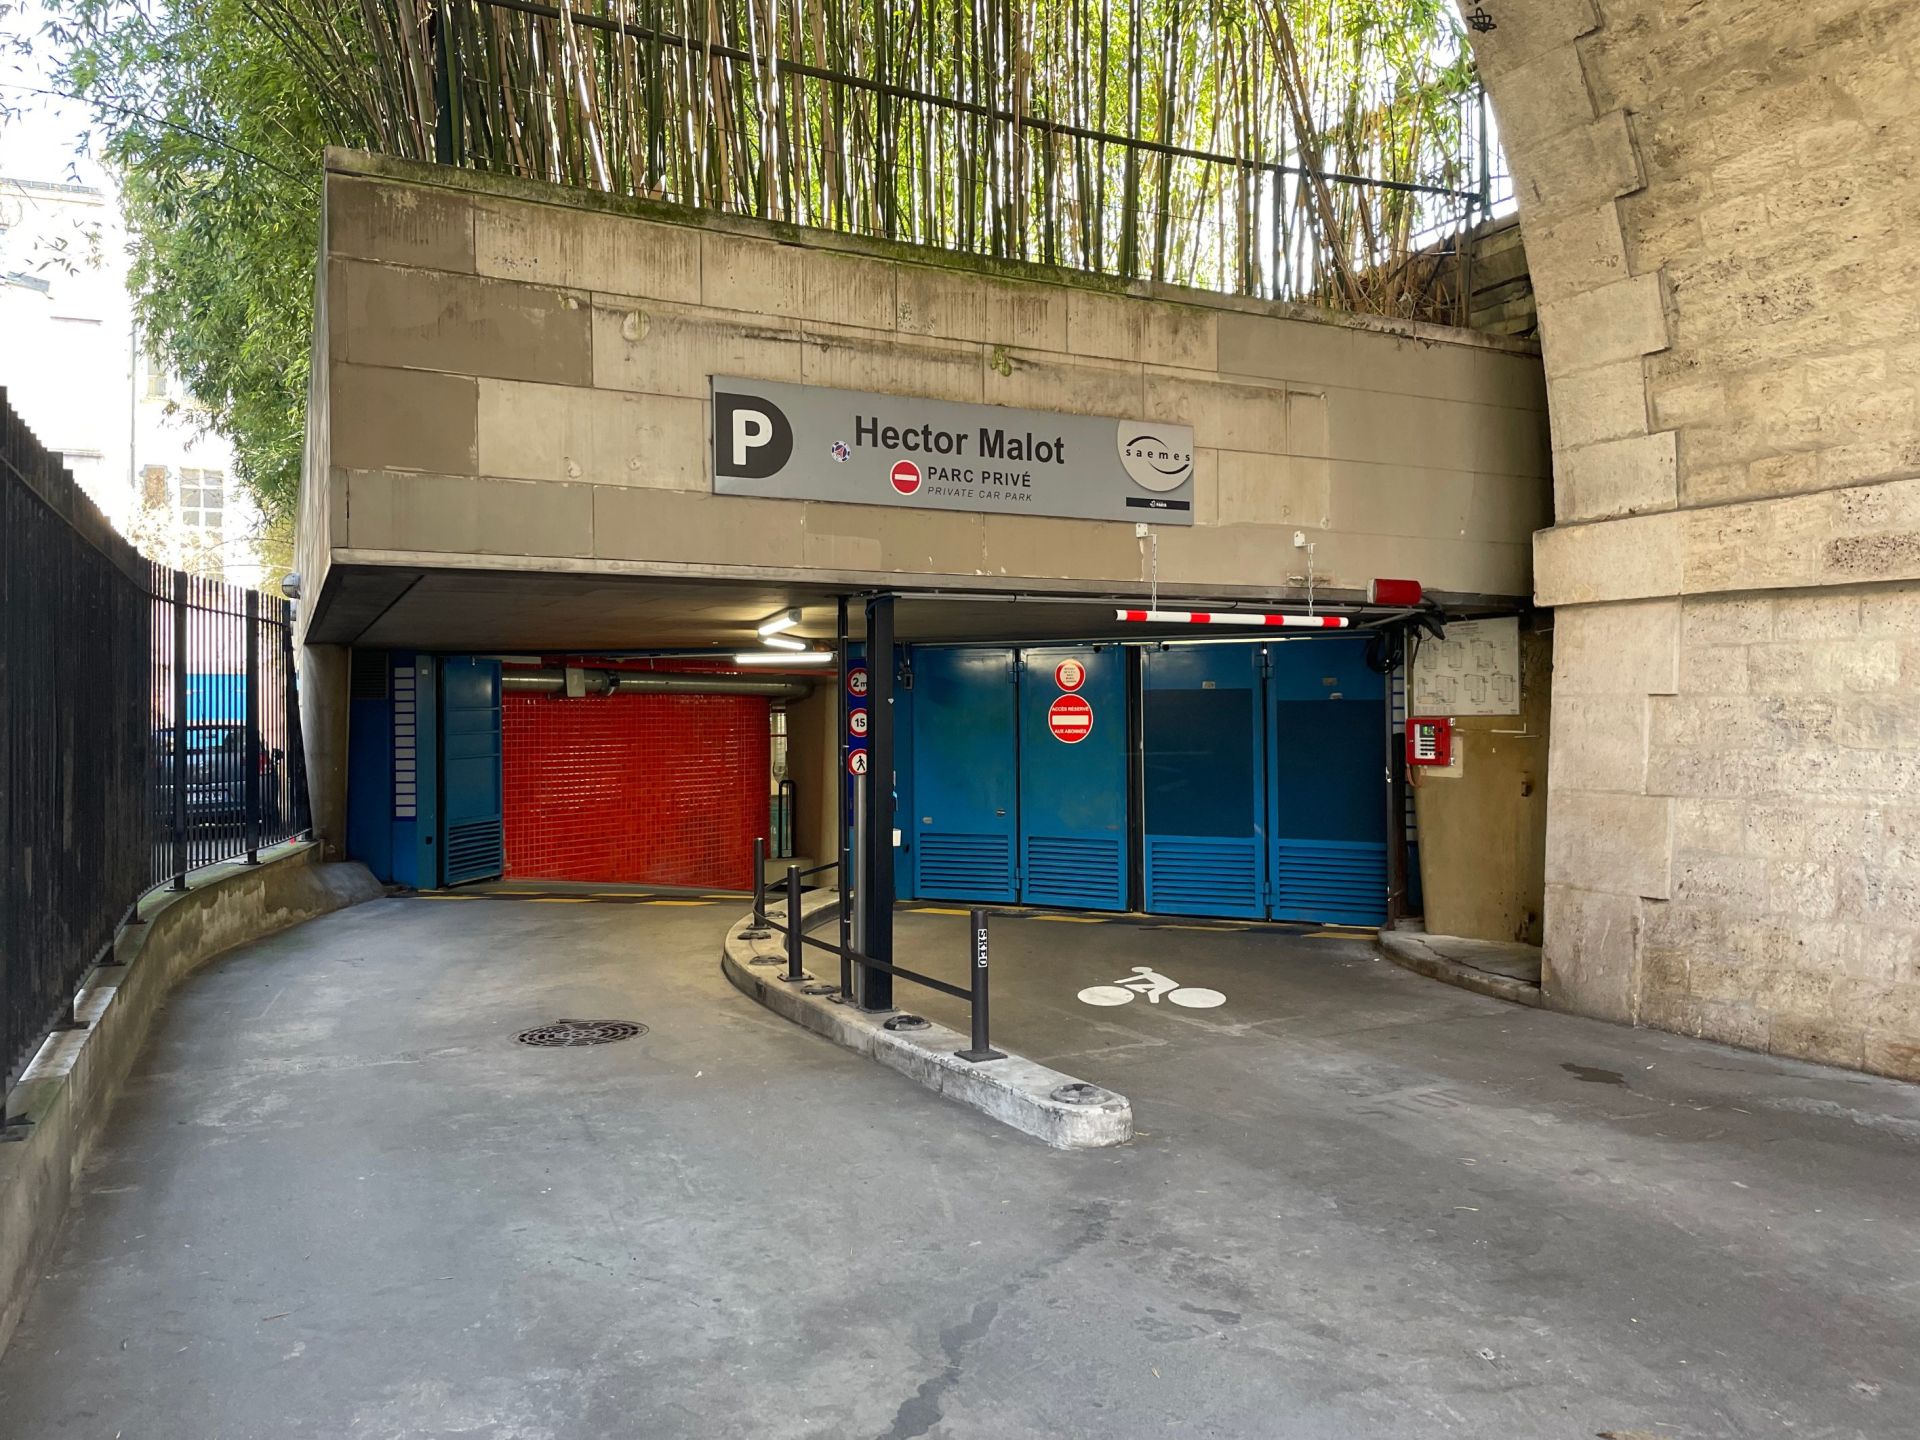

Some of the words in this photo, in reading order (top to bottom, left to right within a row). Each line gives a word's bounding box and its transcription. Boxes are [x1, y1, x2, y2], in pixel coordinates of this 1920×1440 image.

[733, 409, 773, 466] P
[855, 415, 969, 455] Hector
[979, 427, 1065, 464] Malot
[1126, 449, 1190, 461] saemes
[928, 466, 974, 483] PARC
[981, 471, 1031, 488] PRIVÉ
[927, 486, 974, 498] PRIVATE
[978, 490, 1001, 500] CAR
[1004, 492, 1032, 502] PARK
[853, 677, 859, 688] 2
[854, 718, 866, 728] 15
